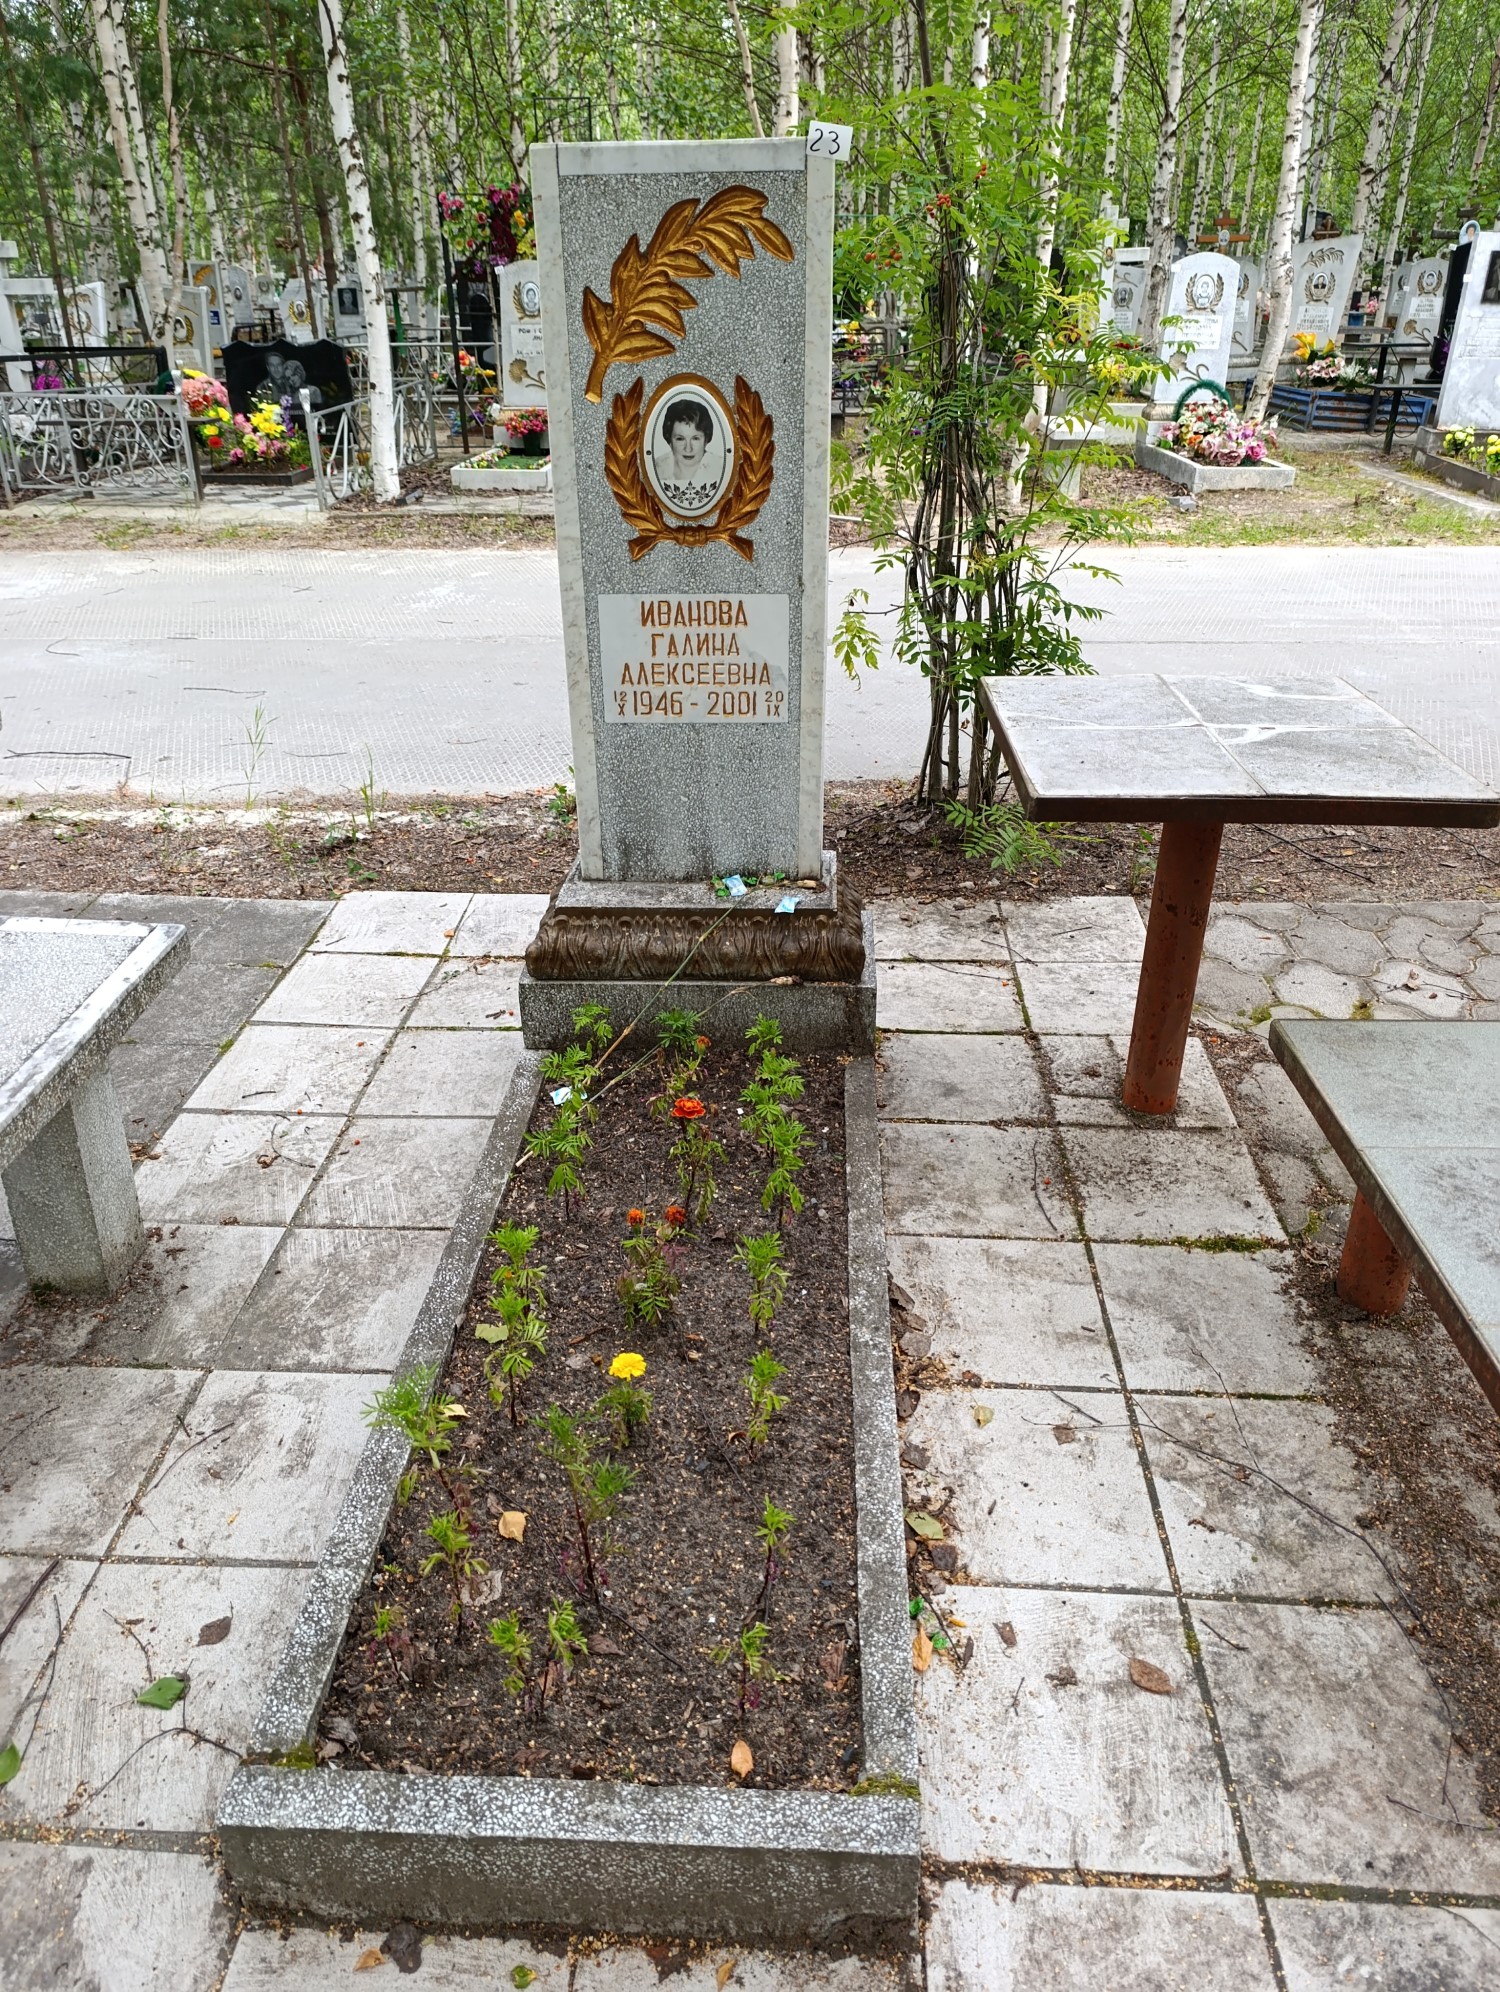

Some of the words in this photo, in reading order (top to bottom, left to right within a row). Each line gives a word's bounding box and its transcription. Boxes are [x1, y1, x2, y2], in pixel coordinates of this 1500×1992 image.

[809, 128, 841, 156] 23
[640, 599, 749, 628] ИВАНОВА
[651, 632, 741, 658] ГАЛИНА
[620, 661, 772, 687] АЛЕКСЕЕВНА
